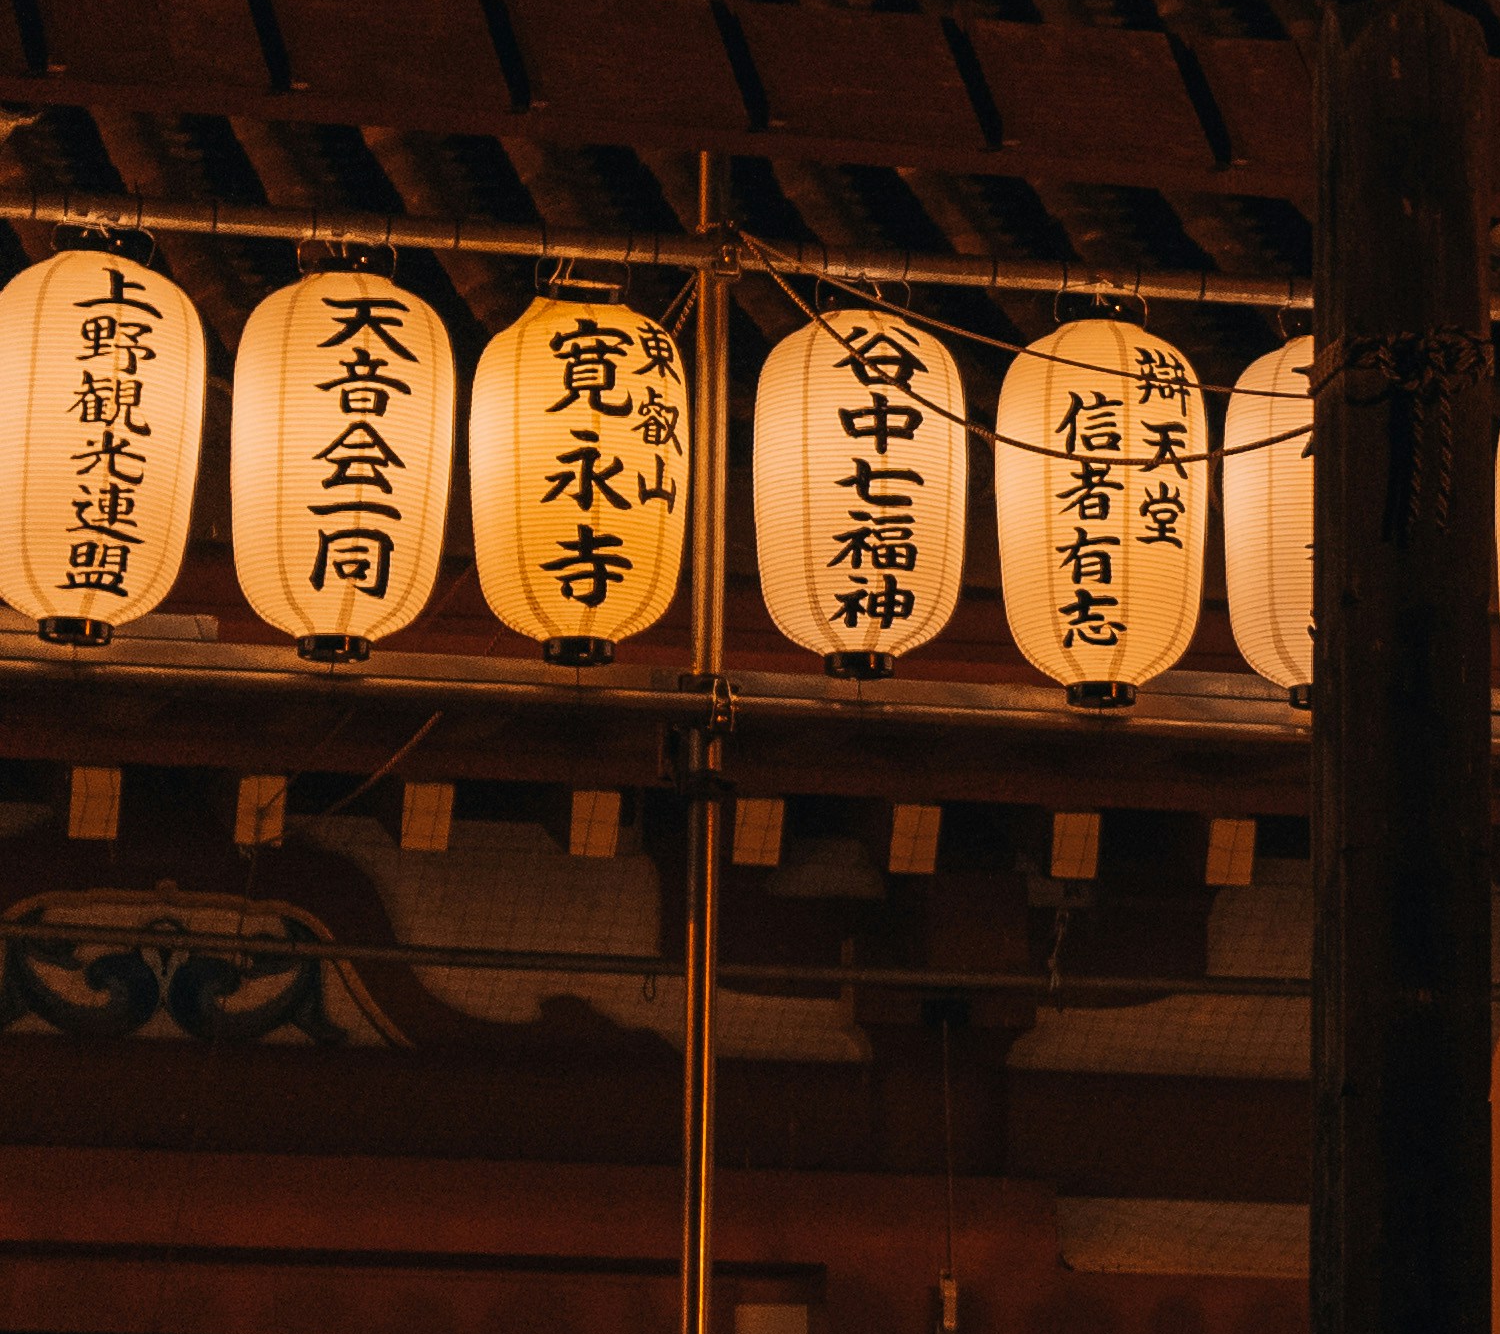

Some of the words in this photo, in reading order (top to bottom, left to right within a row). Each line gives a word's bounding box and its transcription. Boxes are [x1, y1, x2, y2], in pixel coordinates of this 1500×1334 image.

[55, 268, 164, 598] 上野観光連盟
[307, 297, 420, 600] 天音会一同
[538, 318, 636, 607] 寛永寺
[630, 321, 686, 515] 東叡山
[827, 324, 929, 630] 谷中七福神
[1055, 391, 1128, 649] 信者有志
